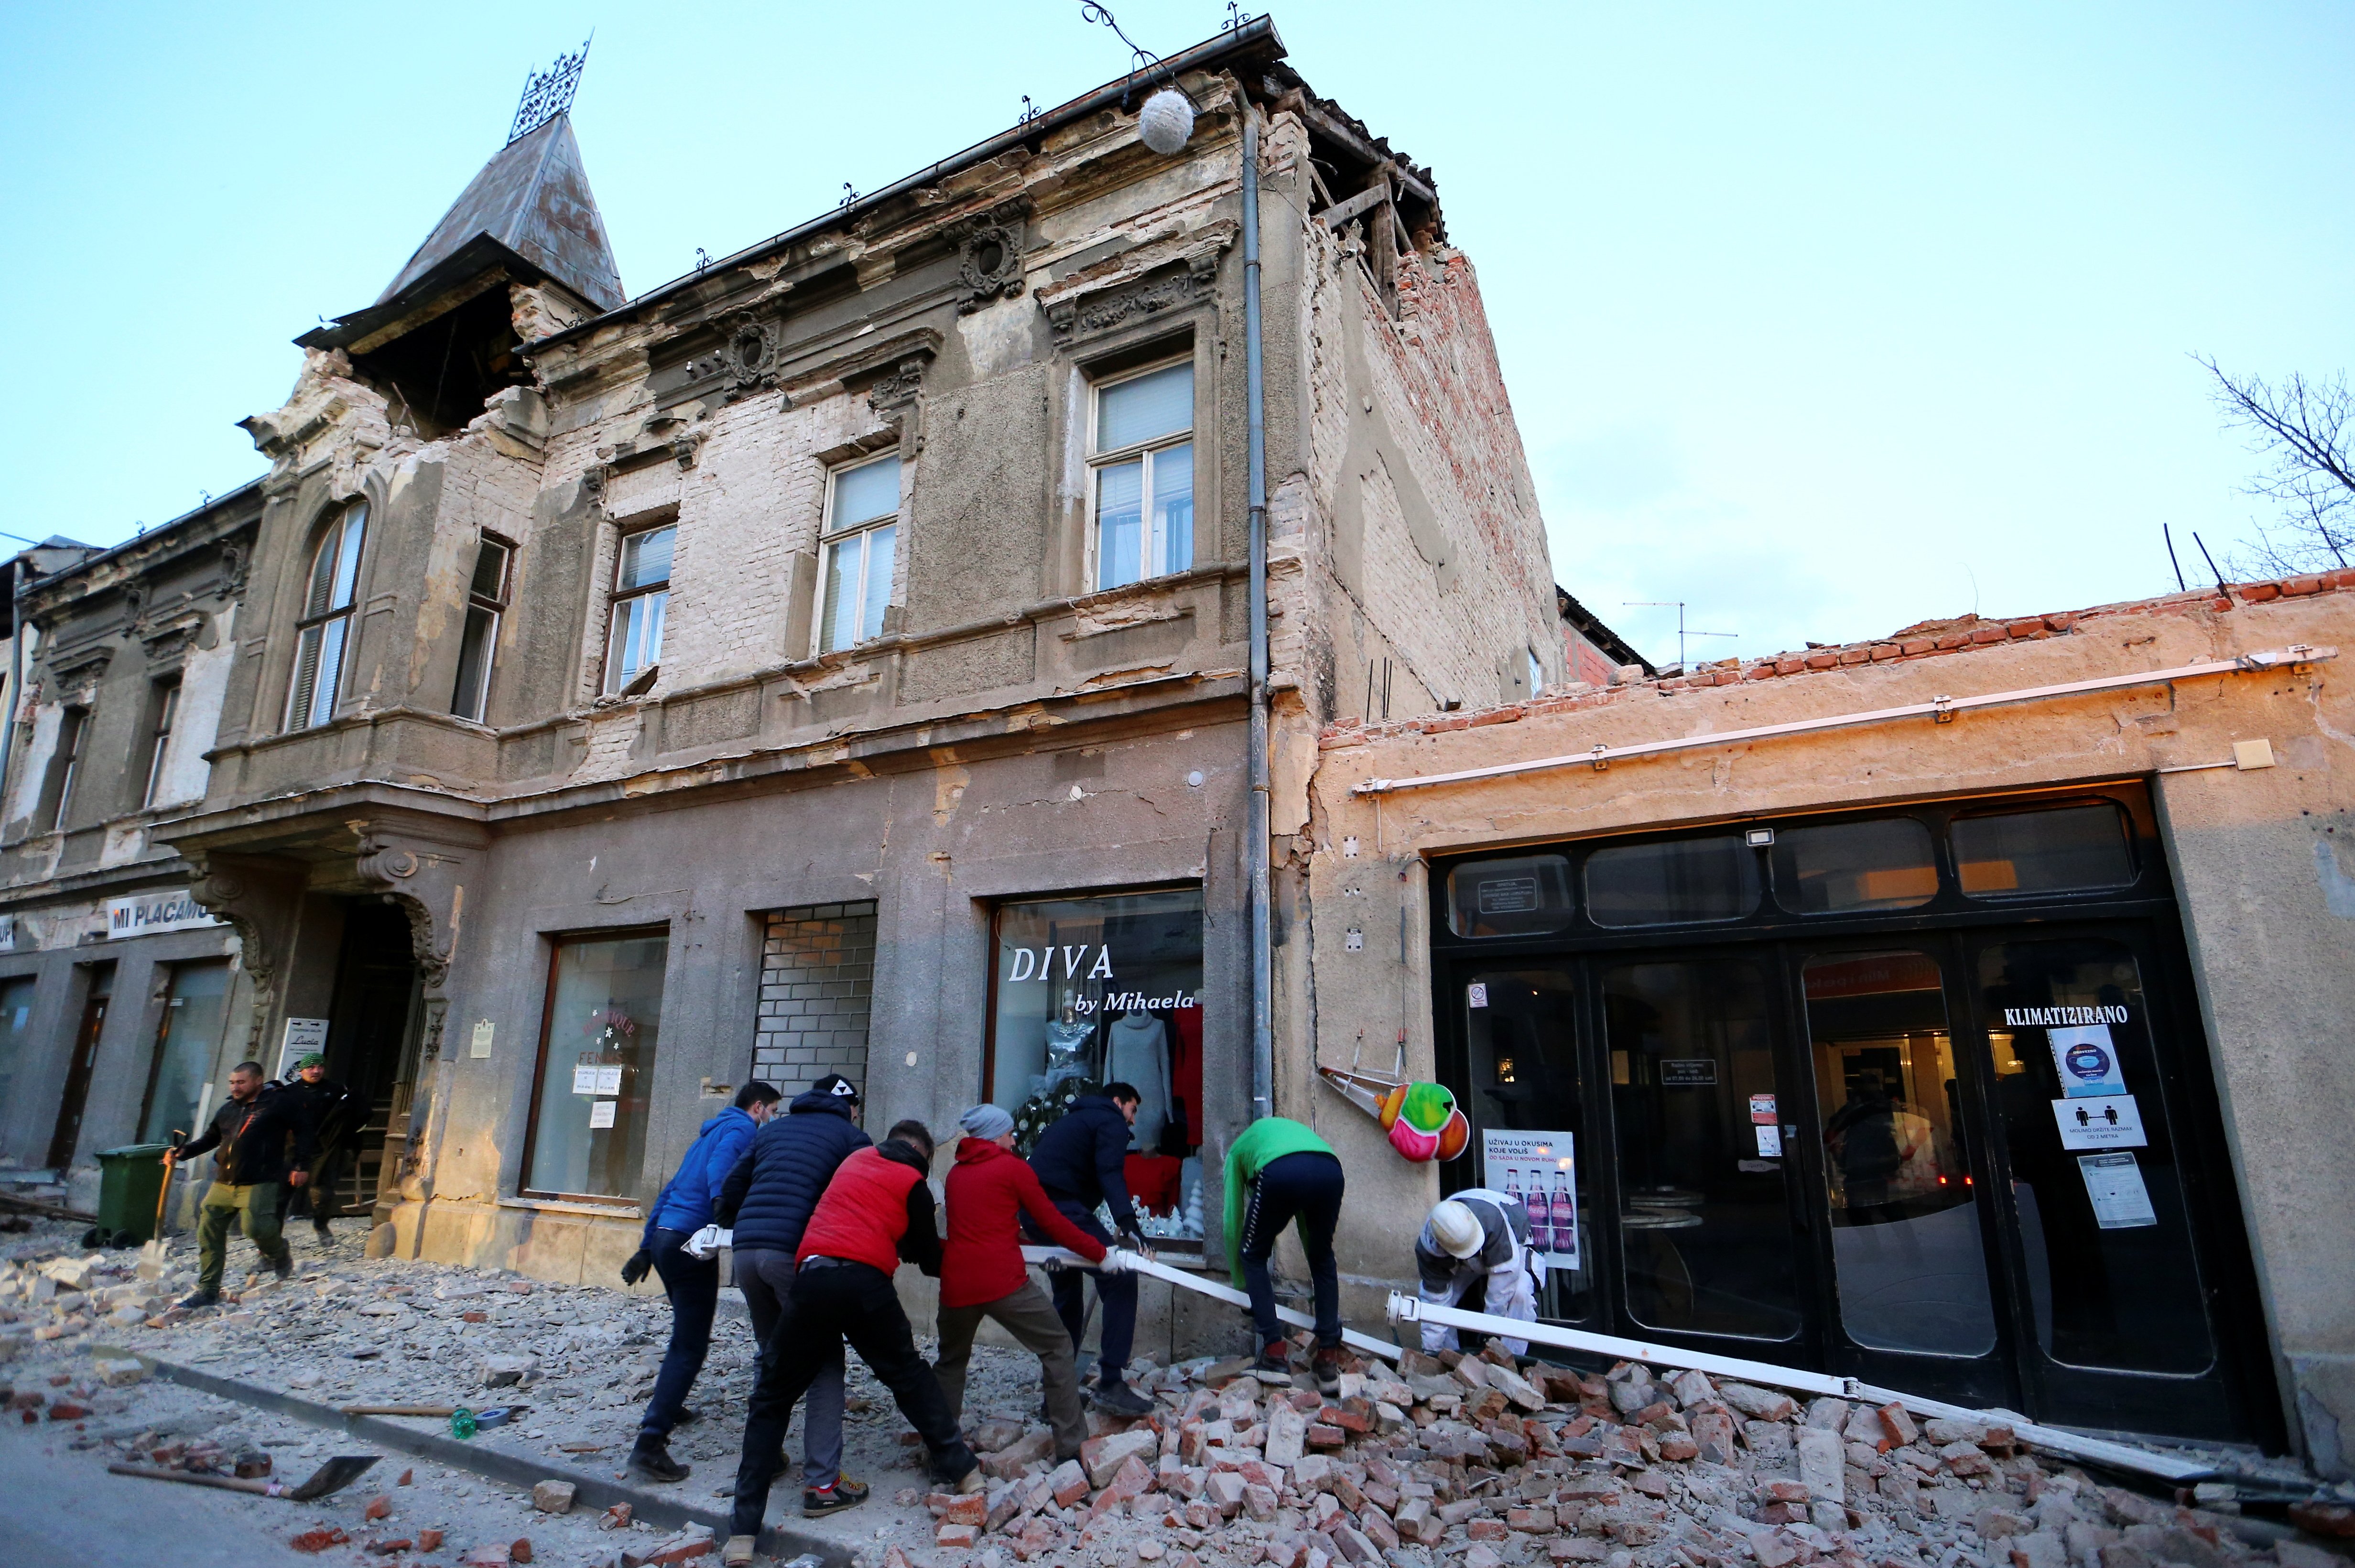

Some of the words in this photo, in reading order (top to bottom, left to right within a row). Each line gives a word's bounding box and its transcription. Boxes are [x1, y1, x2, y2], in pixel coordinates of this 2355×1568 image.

[114, 908, 130, 929] MI
[1008, 943, 1113, 983] DIVA
[1074, 994, 1098, 1015] by
[1104, 990, 1194, 1011] Mihaela
[2004, 1005, 2128, 1026] KLIMATIZIRANO
